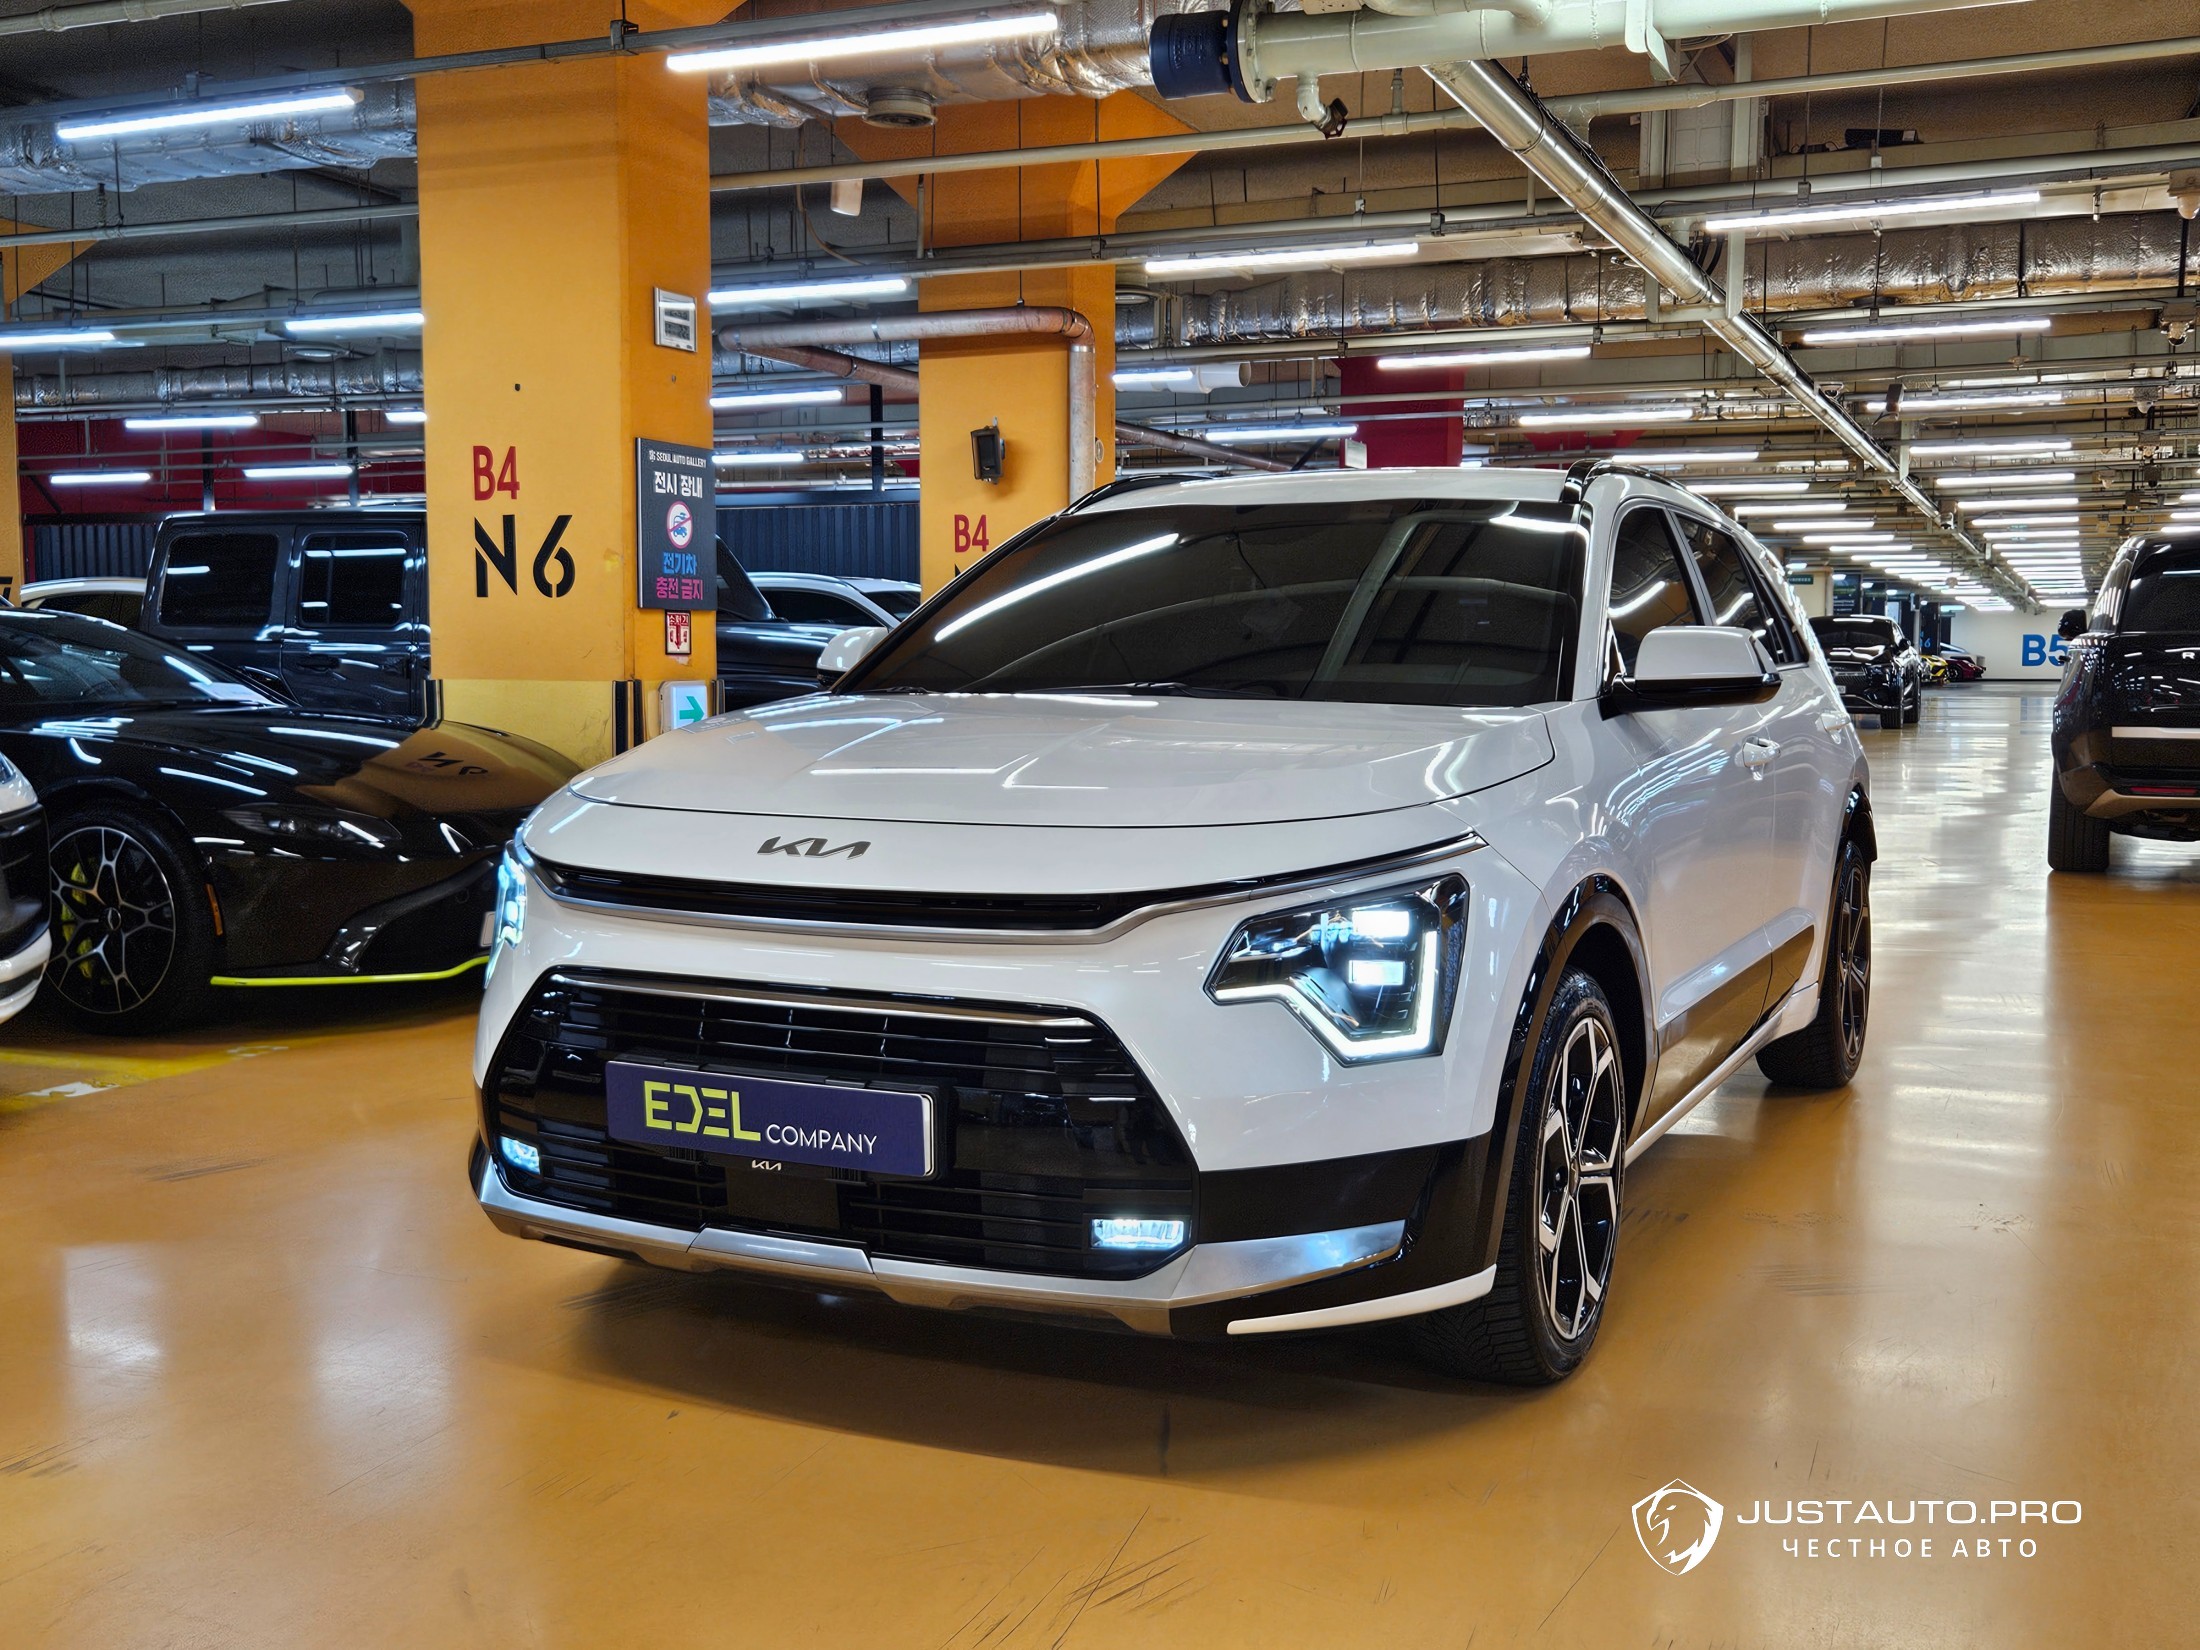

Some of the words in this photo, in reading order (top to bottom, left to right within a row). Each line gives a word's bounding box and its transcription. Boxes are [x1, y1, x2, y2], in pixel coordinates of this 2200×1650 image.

[656, 451, 672, 463] SEOUL
[673, 454, 685, 465] AUTO
[686, 456, 707, 468] GALLERY
[473, 445, 520, 501] B4
[654, 471, 678, 495] 전시
[680, 475, 703, 498] 장내
[954, 514, 989, 553] B4
[663, 551, 697, 575] 전기차
[656, 576, 679, 599] 충전
[681, 578, 703, 600] 금지
[757, 836, 871, 860] KIA
[644, 1080, 761, 1142] EDEL
[766, 1123, 877, 1155] COMPANY
[751, 1159, 782, 1171] KIA
